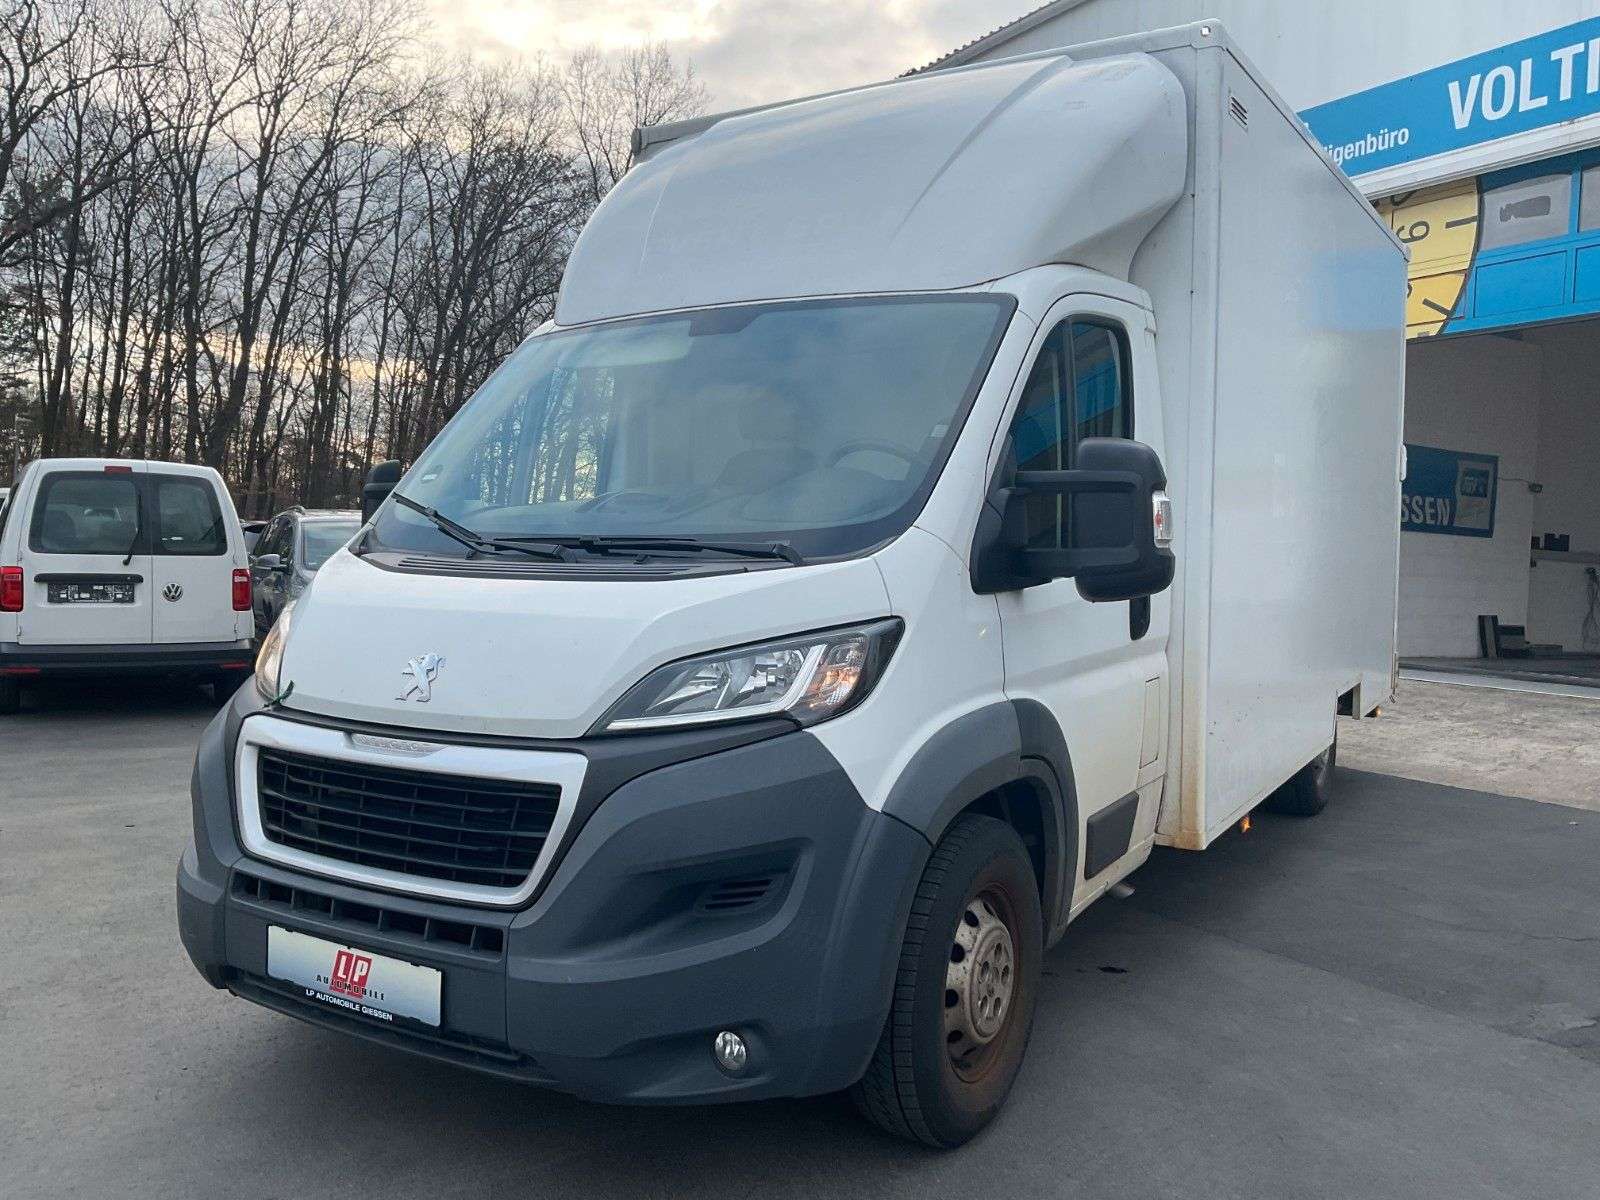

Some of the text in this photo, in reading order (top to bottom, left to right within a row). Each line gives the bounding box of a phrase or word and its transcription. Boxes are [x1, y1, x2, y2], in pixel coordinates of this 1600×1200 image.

[1323, 128, 1409, 167] igenbüro
[337, 954, 369, 983] LP
[305, 988, 393, 1022] LP AUTOMOBILE GIESSEN
